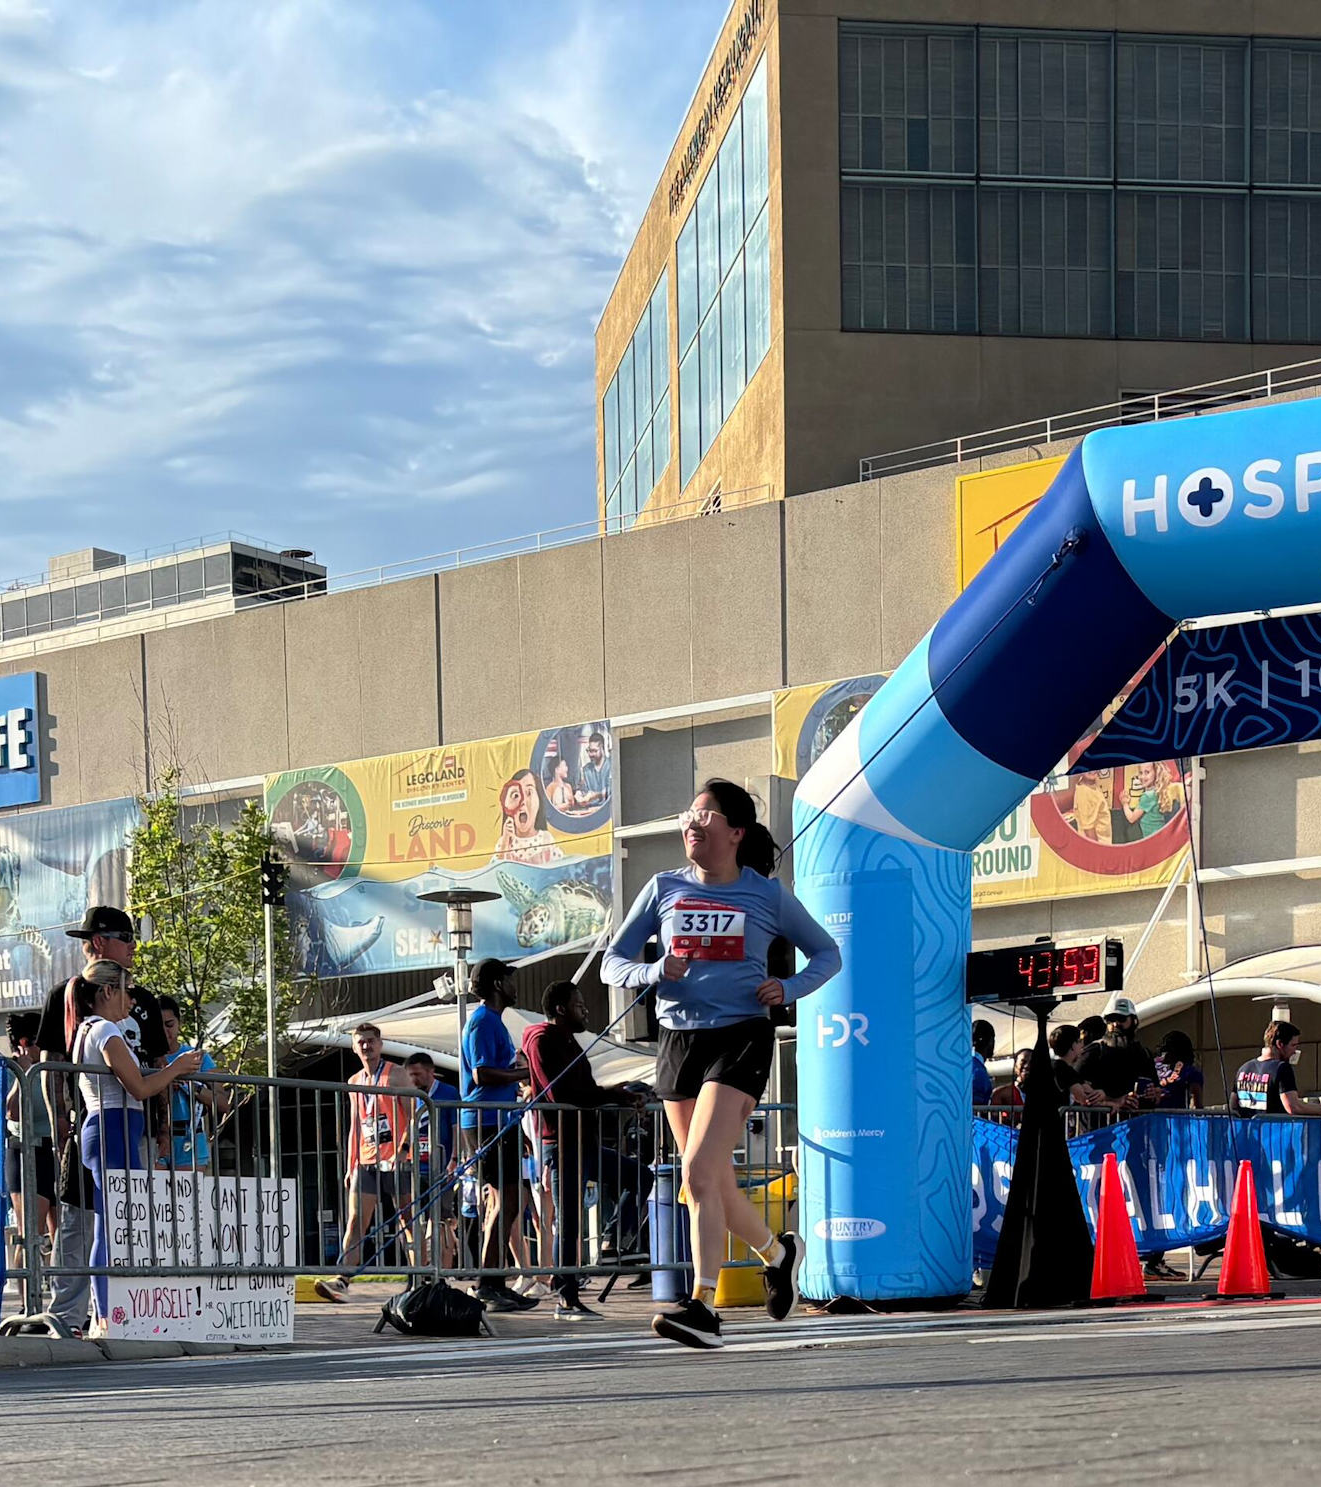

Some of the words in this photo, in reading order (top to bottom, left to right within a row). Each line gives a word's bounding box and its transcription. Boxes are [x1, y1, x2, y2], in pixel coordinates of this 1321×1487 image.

[1173, 669, 1238, 715] 5K
[406, 767, 466, 786] LEGOLAND
[408, 814, 455, 837] Discover
[388, 823, 476, 863] LAND
[680, 913, 736, 933] 3317
[1018, 945, 1099, 989] 43:53
[816, 1012, 871, 1049] HDR
[857, 1128, 885, 1138] Mercy
[254, 1188, 290, 1216] STOP
[254, 1223, 291, 1253] STOP
[212, 1298, 291, 1330] SWEETHEART
